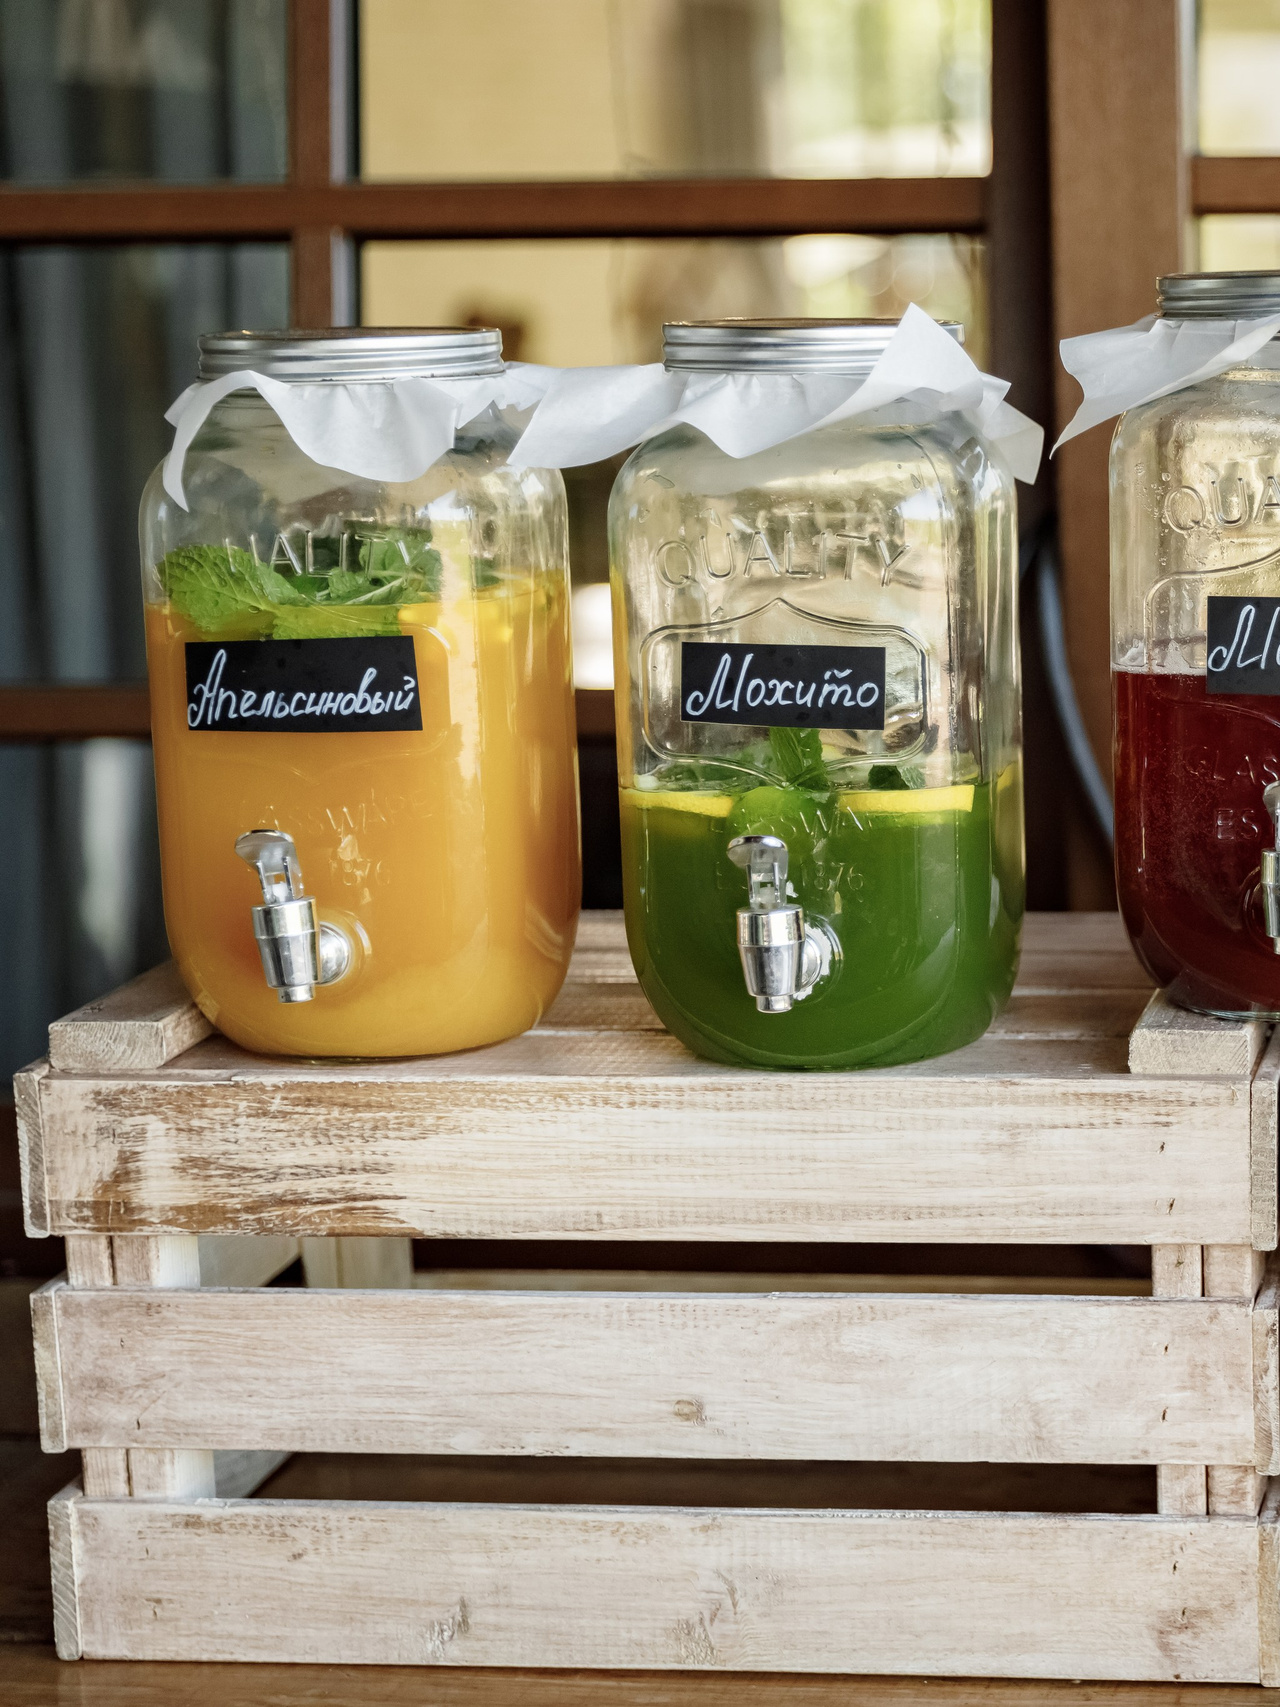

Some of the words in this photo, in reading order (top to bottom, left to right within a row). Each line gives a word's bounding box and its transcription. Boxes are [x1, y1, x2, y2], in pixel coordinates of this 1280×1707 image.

[222, 530, 429, 582] UALITY
[654, 530, 912, 589] QUALITY
[187, 648, 417, 728] Апельсиновый
[685, 652, 879, 717] Мохито
[1214, 807, 1262, 841] ES
